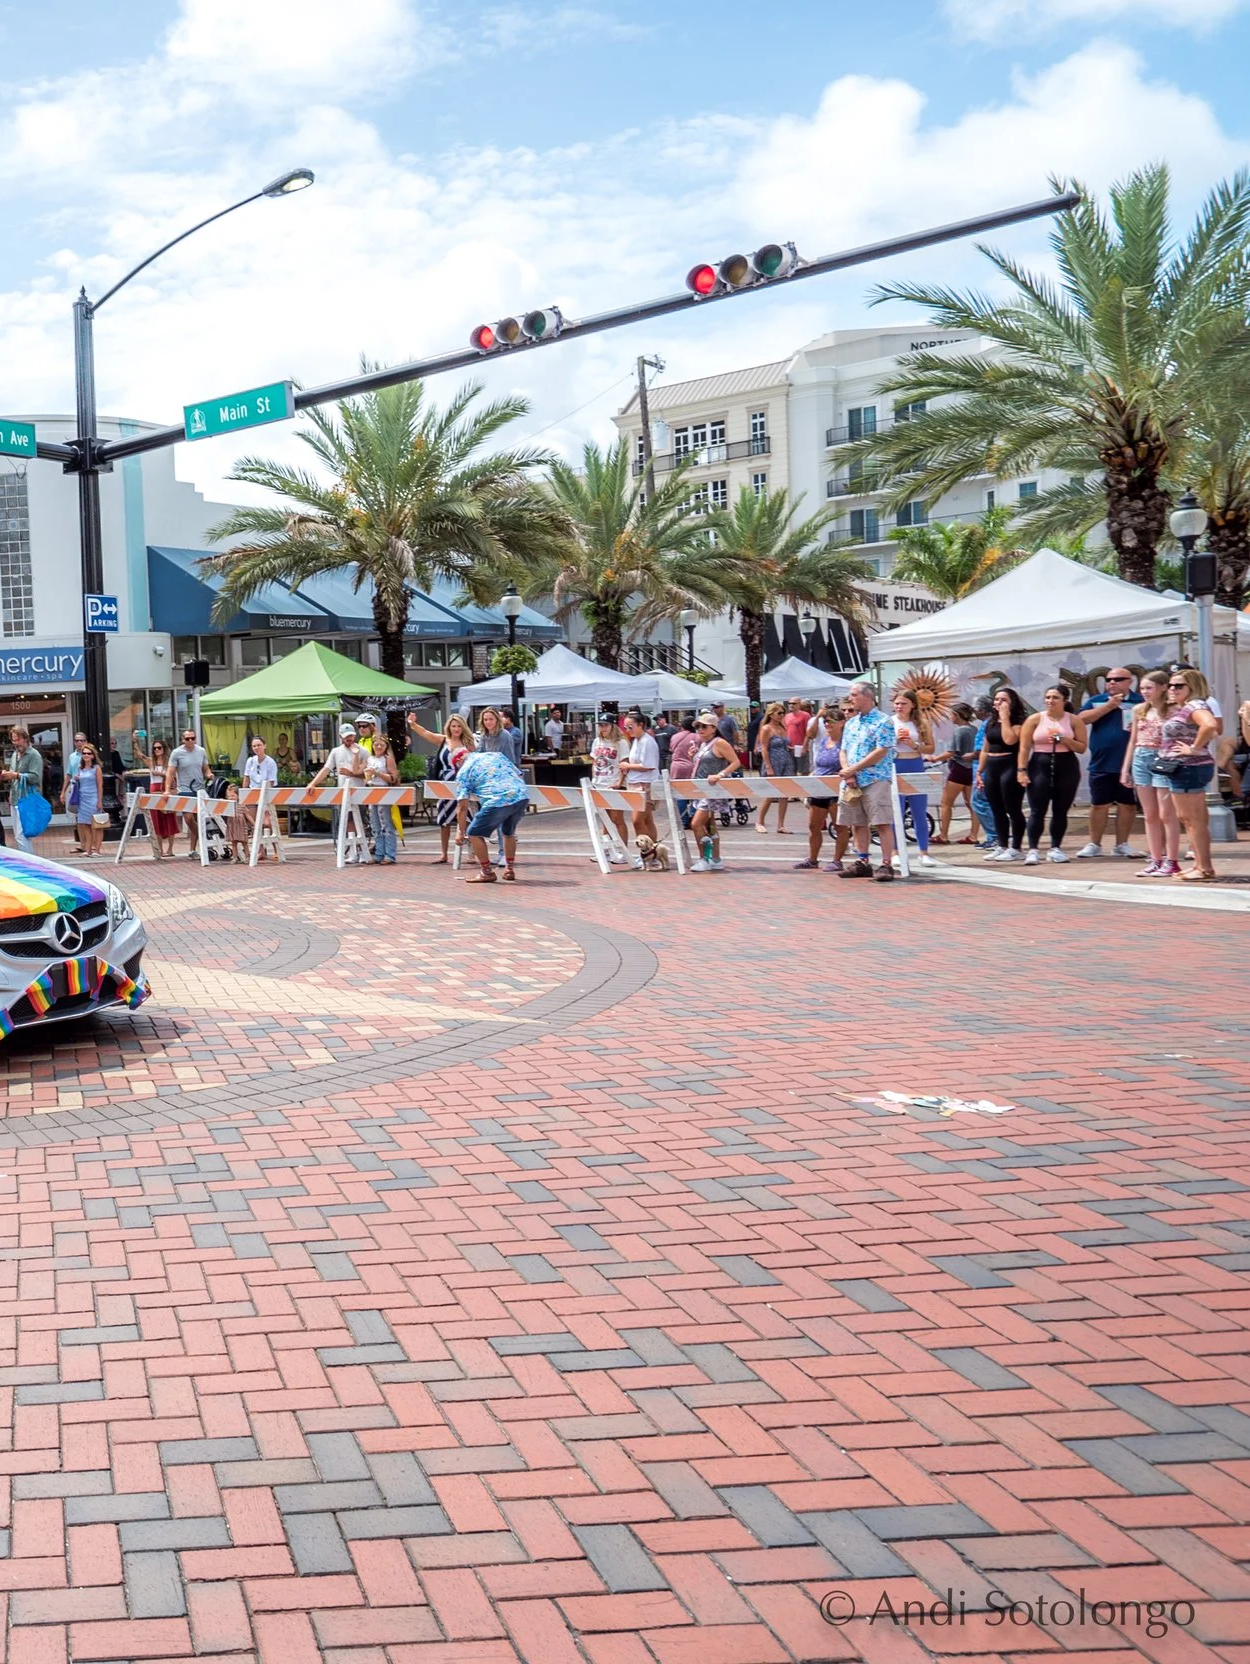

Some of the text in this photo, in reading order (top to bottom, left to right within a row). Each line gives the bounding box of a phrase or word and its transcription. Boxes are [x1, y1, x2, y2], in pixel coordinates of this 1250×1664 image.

[219, 396, 271, 423] Main St
[10, 430, 29, 447] Ave
[87, 598, 118, 627] PARKING
[269, 615, 312, 630] bluemercury
[46, 673, 63, 682] spa
[11, 701, 31, 710] 1500
